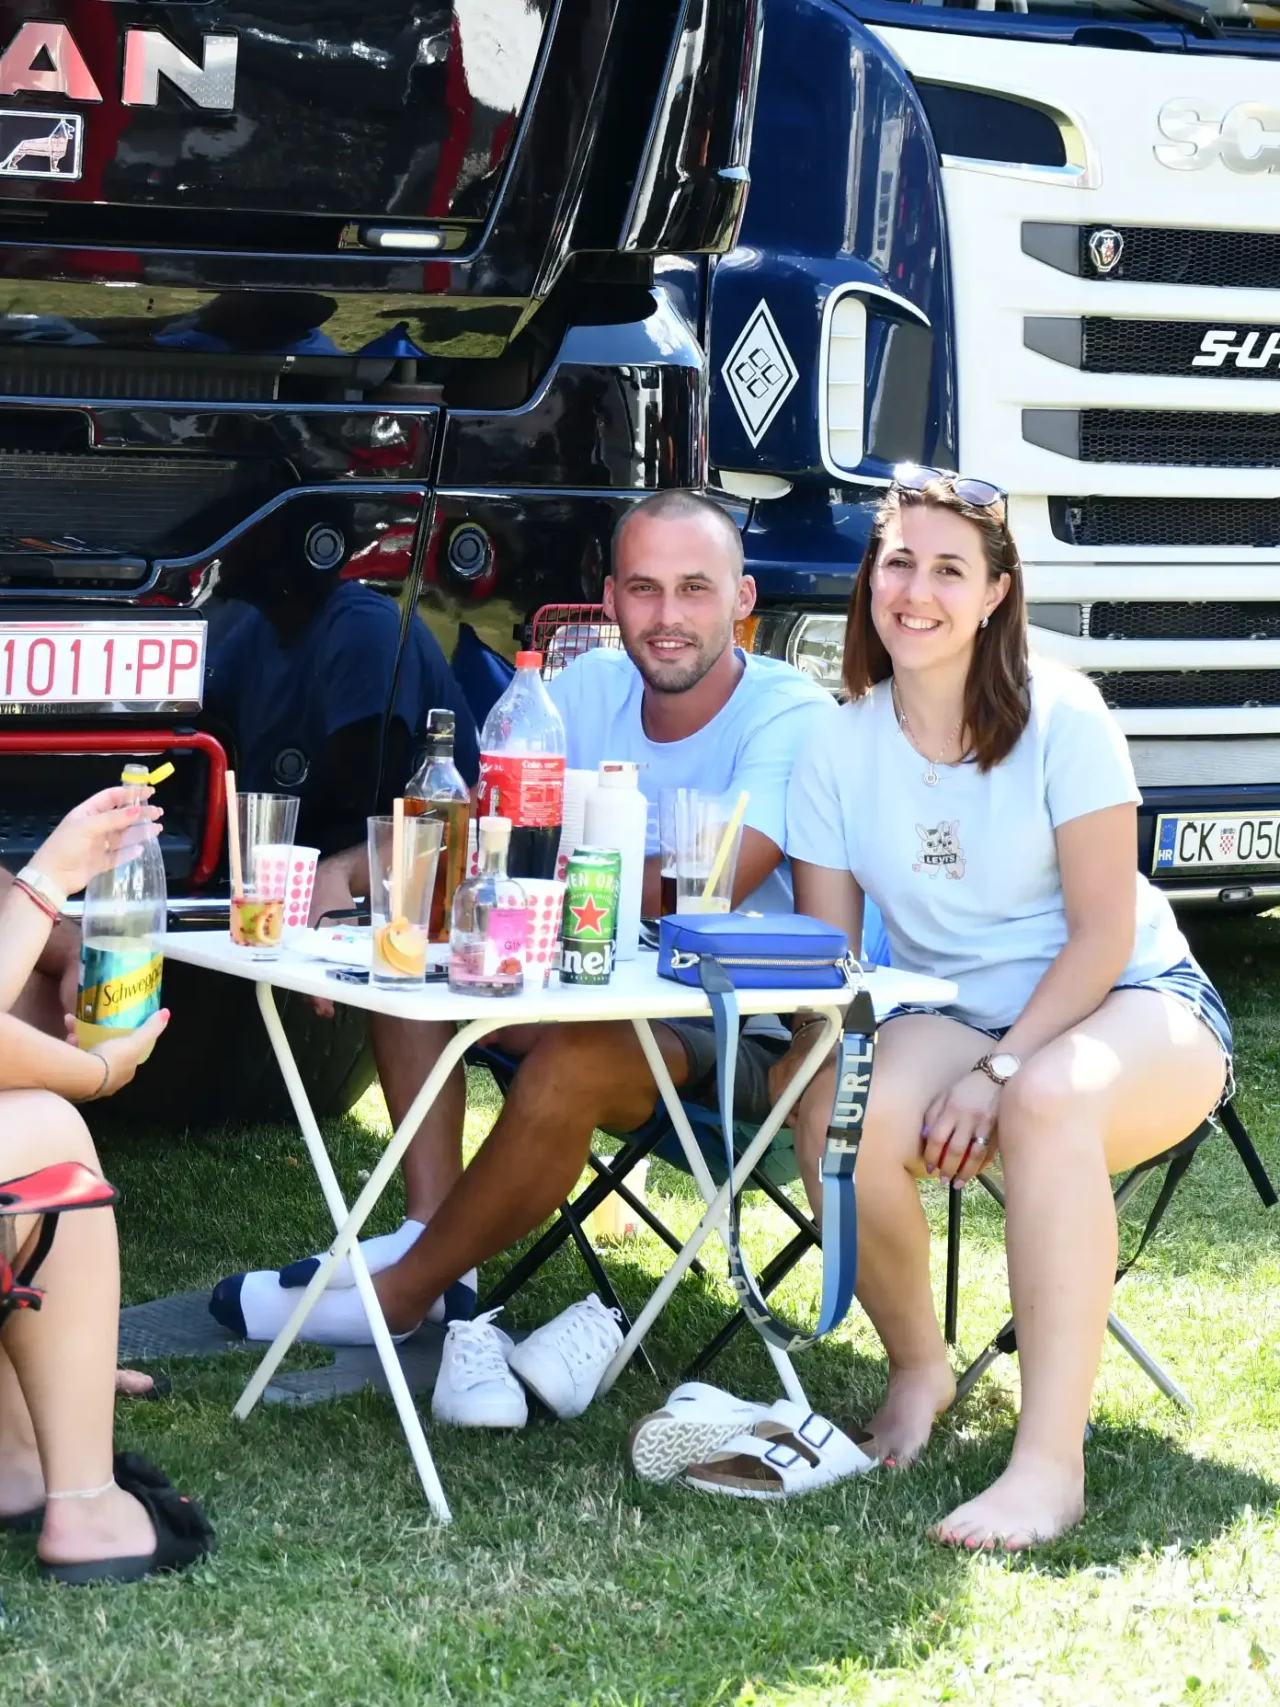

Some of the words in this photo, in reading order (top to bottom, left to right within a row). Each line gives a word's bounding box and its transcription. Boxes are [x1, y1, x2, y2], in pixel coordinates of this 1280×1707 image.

[1153, 96, 1280, 175] SC
[1191, 330, 1280, 368] SU
[1158, 849, 1173, 861] HR
[1179, 821, 1217, 862] ČK
